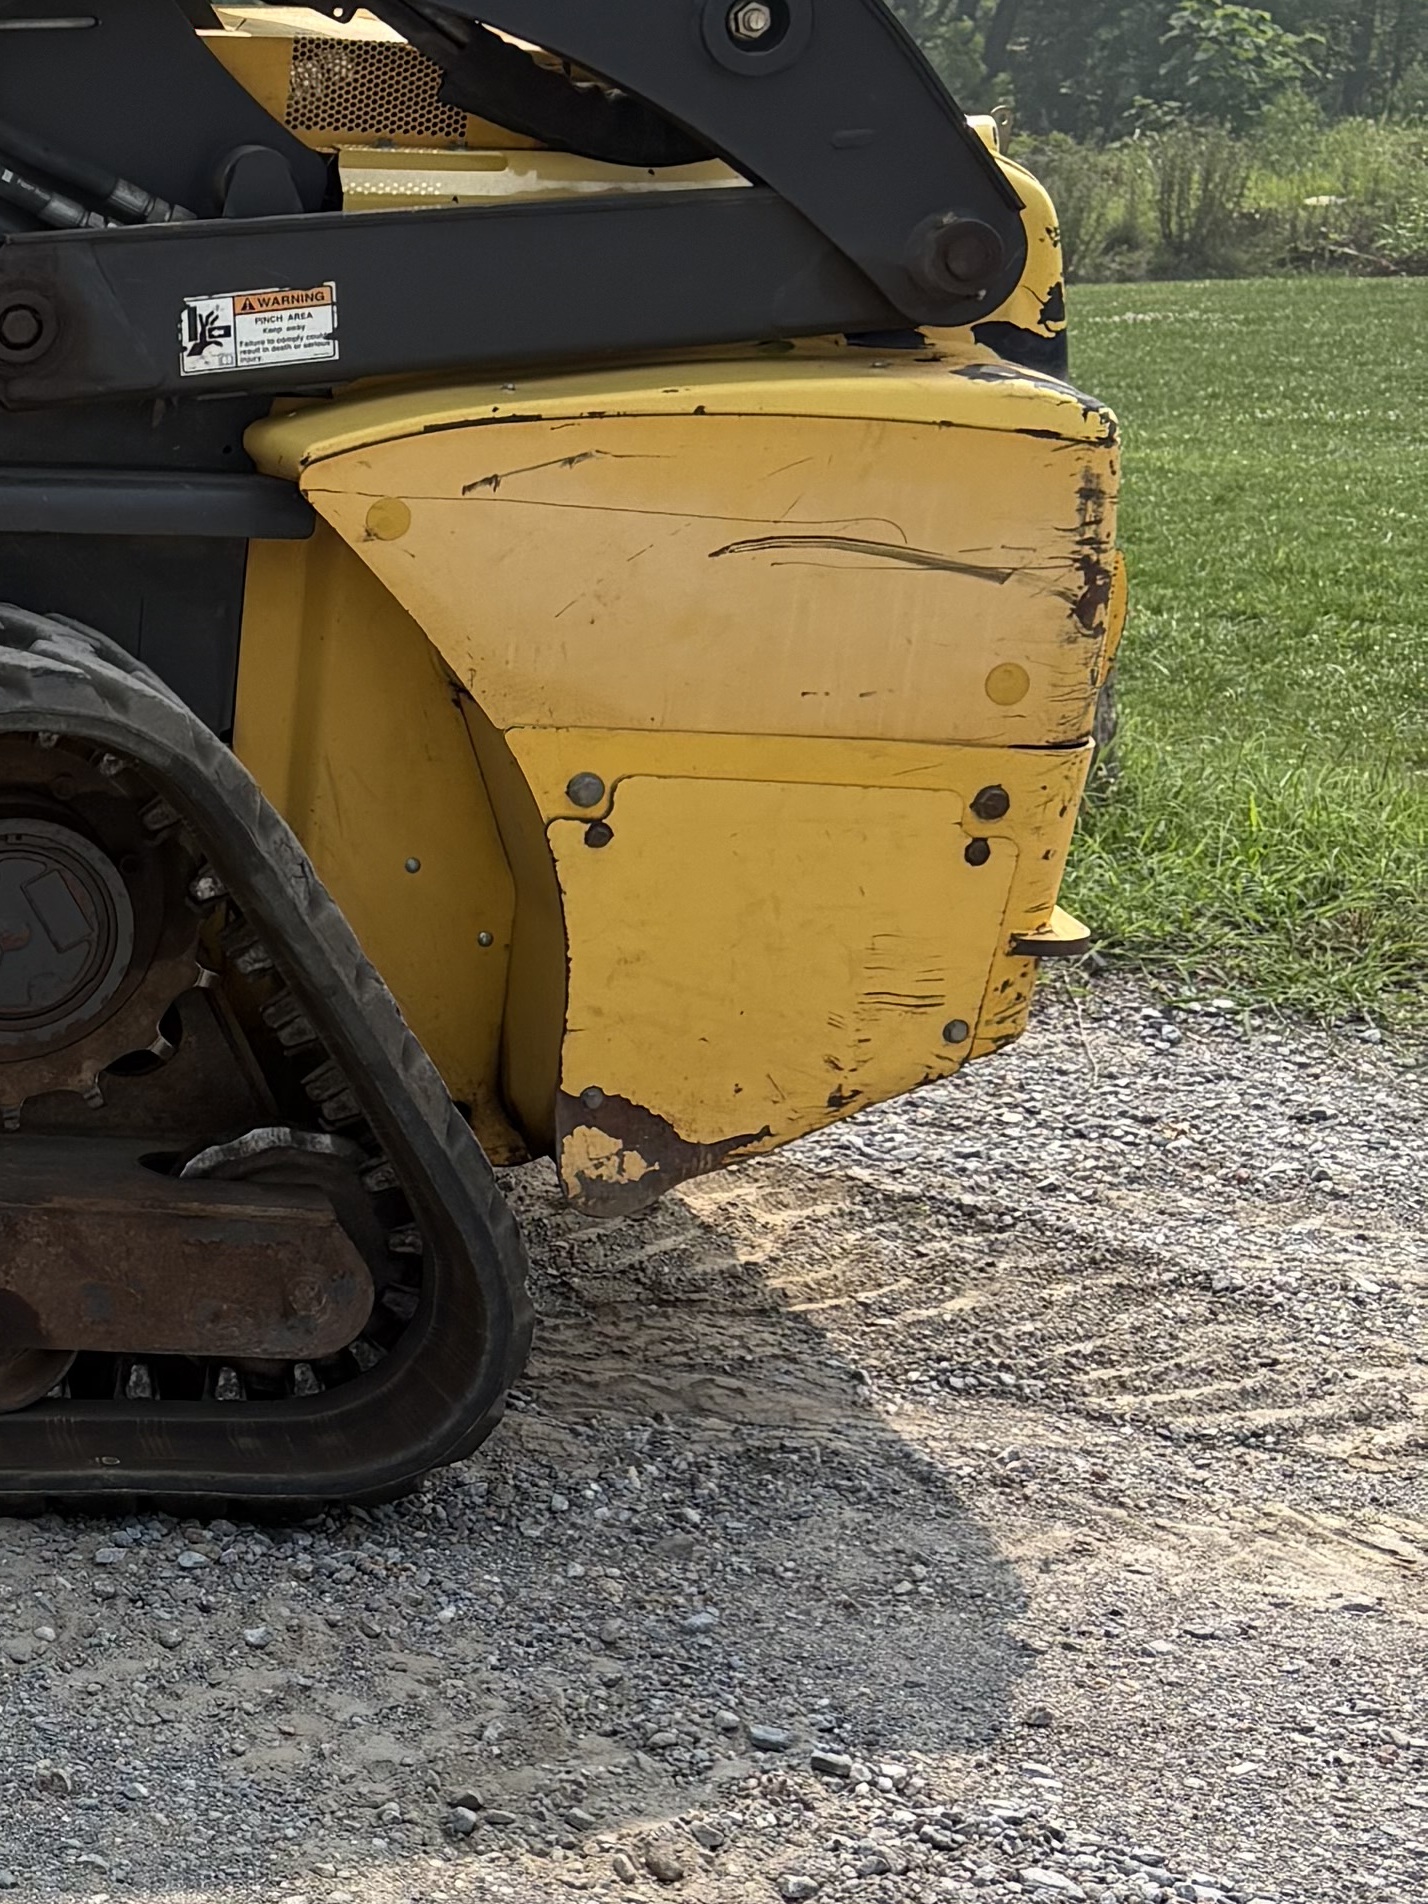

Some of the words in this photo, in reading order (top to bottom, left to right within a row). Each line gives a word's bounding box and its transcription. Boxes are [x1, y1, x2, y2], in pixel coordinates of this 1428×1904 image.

[256, 291, 325, 308] WARNING
[255, 314, 283, 325] PINCH
[287, 311, 313, 321] AREA
